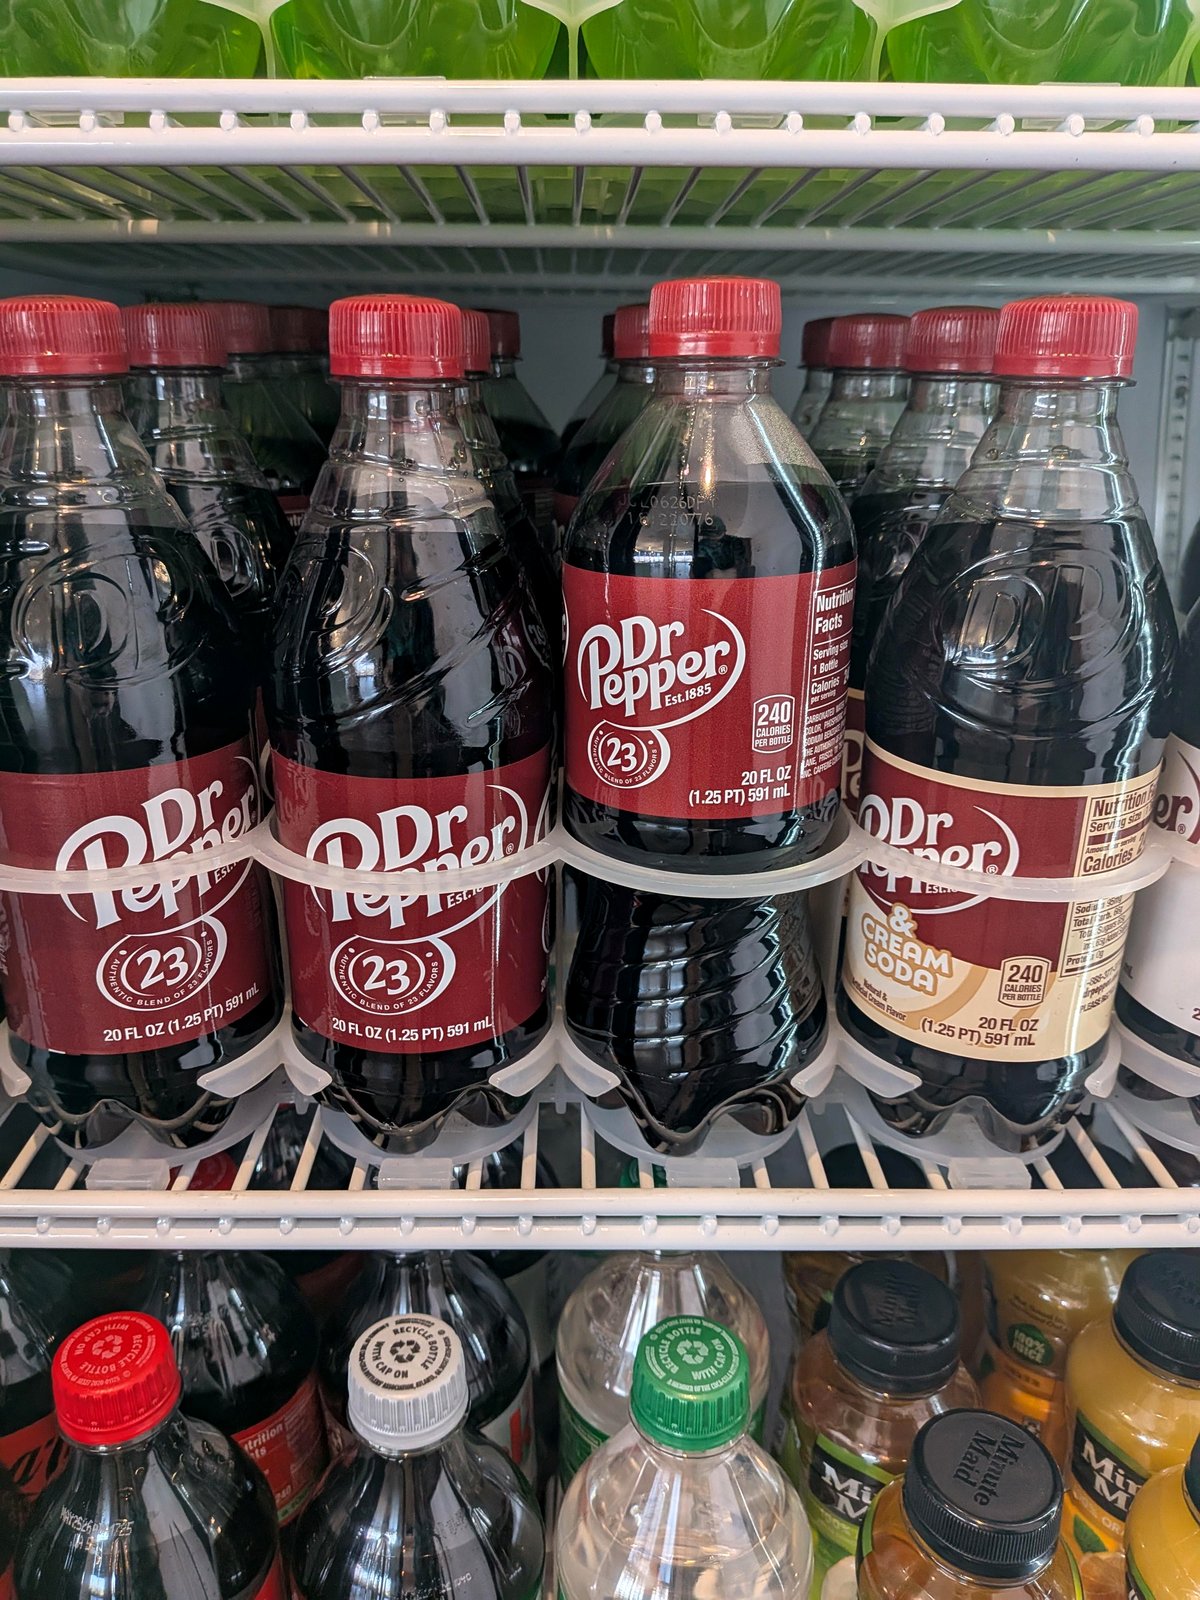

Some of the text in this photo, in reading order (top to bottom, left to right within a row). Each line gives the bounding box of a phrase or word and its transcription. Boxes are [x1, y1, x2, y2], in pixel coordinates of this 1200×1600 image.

[816, 588, 854, 613] Nutrition
[815, 613, 843, 635] Facts
[620, 615, 685, 669] Dr
[813, 644, 839, 660] Serving
[577, 624, 731, 717] Pepper
[819, 659, 839, 674] Bottle
[811, 676, 840, 695] Calories
[757, 701, 791, 726] 240
[755, 735, 791, 748] PER BOTTLE
[756, 724, 791, 738] CALORIES
[607, 737, 637, 772] 23
[741, 765, 792, 786] 20 FL OZ
[689, 783, 790, 807] (1.25 PT) 591 mL
[142, 780, 223, 861] Dr
[890, 796, 953, 846] Dr
[377, 804, 468, 872] Dr
[1083, 847, 1134, 873] Calories
[888, 904, 916, 939] &
[863, 916, 950, 976] CREAM
[109, 939, 213, 1006] AUTHENTIC BLEND OF 23 FLAVORS
[137, 946, 189, 990] 23
[338, 954, 439, 1011] AUTHENTIC BLEND OF 23 FLAVORS
[362, 955, 411, 996] 23
[866, 942, 935, 993] SODA
[1007, 964, 1043, 983] 240
[1002, 993, 1041, 1001] PER BOTTLE
[1004, 983, 1042, 993] CALORIES
[103, 982, 260, 1042] 20 FL OZ (1.25 PT) 591 mL
[978, 1016, 1040, 1031] 20 FL OZ
[332, 1016, 493, 1043] 20 FL OZ (1.25 PT) 591 mL
[921, 1017, 1036, 1046] (1.25 PT) 591 mL
[119, 1334, 143, 1368] RECYCLE
[392, 1325, 434, 1341] RECYCLE
[420, 1339, 439, 1370] BOTTLE
[665, 1327, 702, 1341] BOTTLE
[79, 1361, 117, 1375] BOTTLE
[375, 1361, 393, 1376] CAP
[393, 1370, 409, 1379] ON
[659, 1339, 679, 1374] RECYCLE
[691, 1338, 726, 1380] WITH CAP ON
[952, 1430, 998, 1488] Maid
[974, 1433, 1025, 1506] Minute
[821, 1461, 877, 1504] Mi
